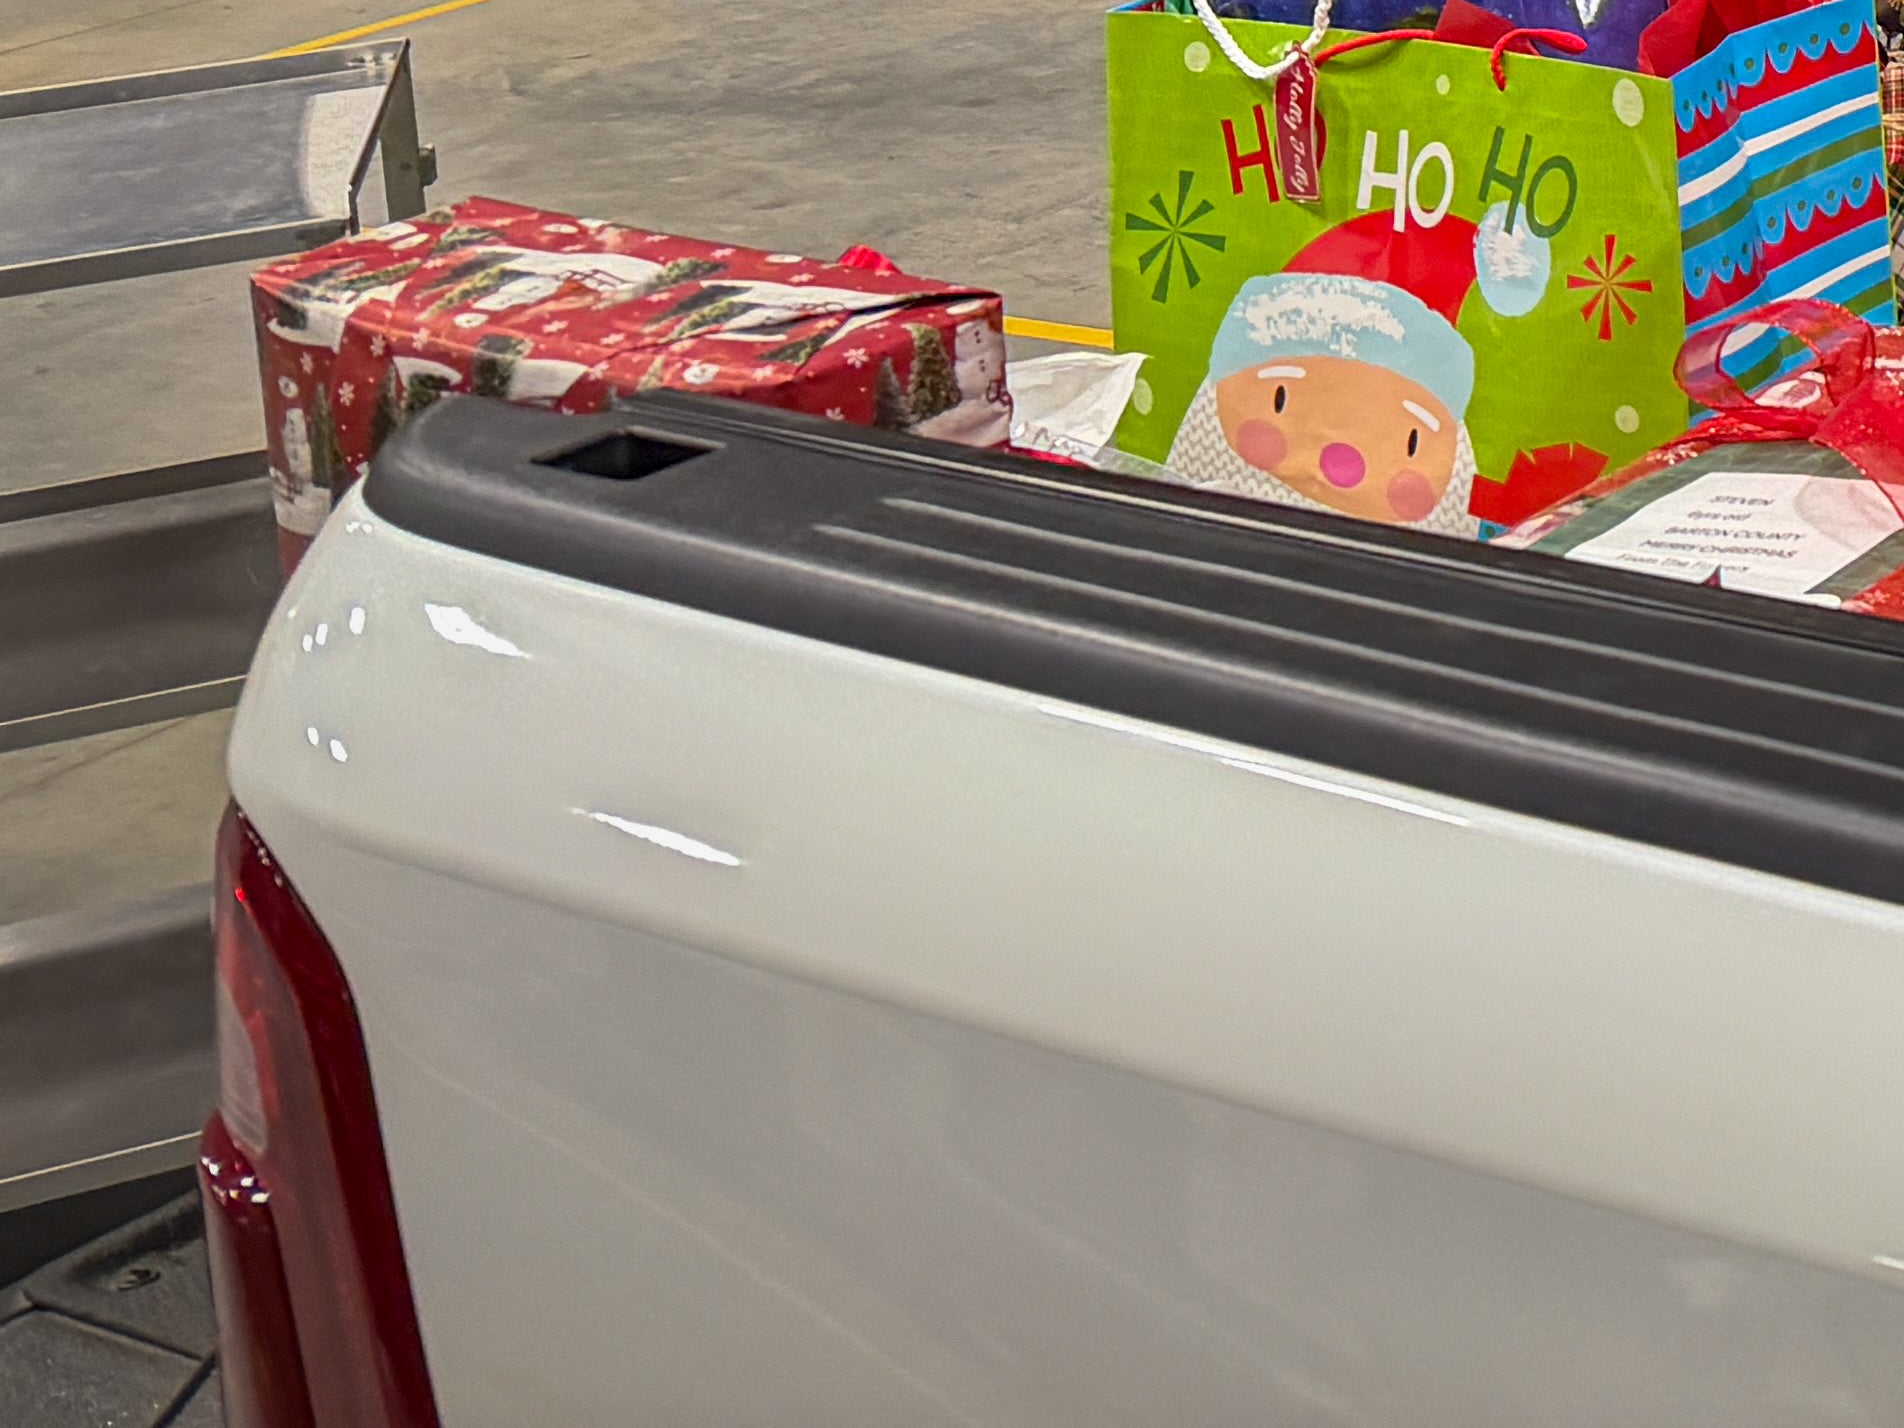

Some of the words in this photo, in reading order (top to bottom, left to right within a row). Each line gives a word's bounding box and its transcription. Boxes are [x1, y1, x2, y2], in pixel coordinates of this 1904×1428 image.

[1357, 129, 1454, 232] HO
[1479, 126, 1578, 238] HO
[1709, 495, 1775, 506] STEVEN
[1665, 526, 1731, 537] BARTON
[1733, 530, 1806, 542] COUNTY
[1639, 539, 1697, 552] MERRY
[1699, 544, 1798, 558] CHRISTMAS
